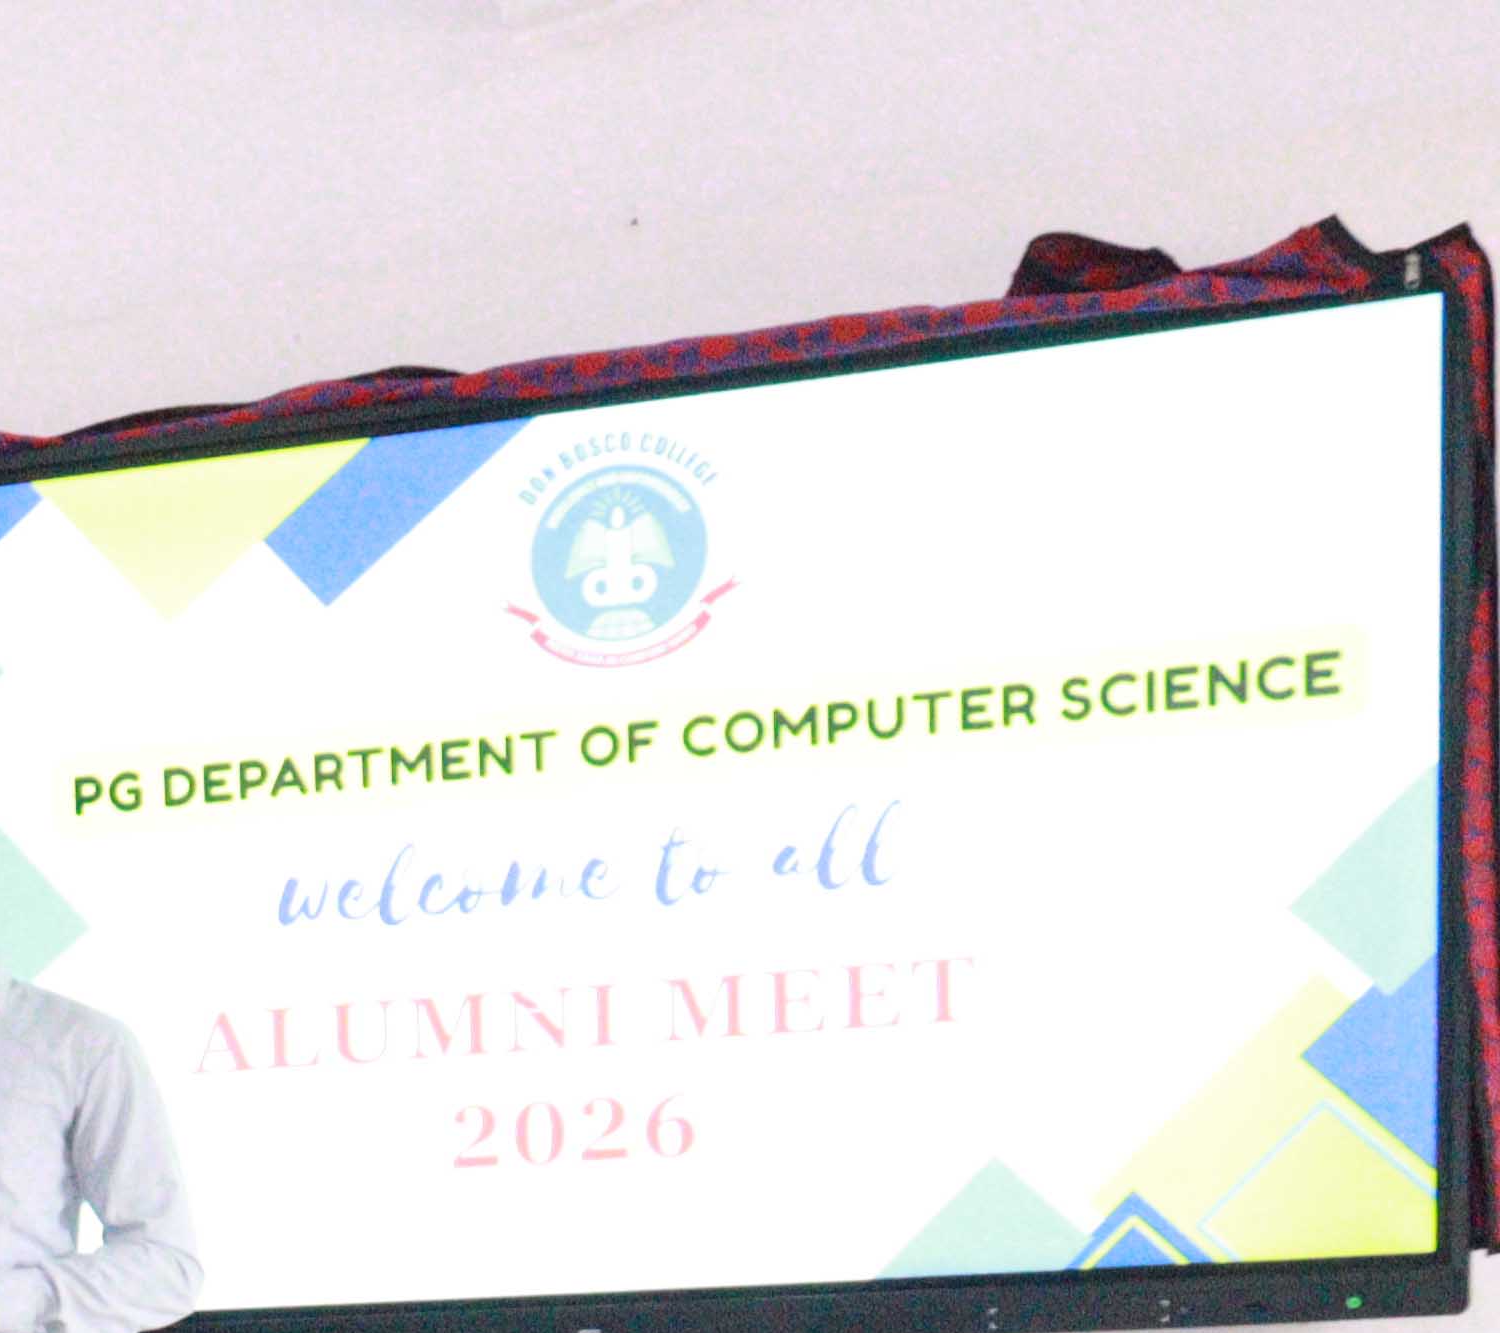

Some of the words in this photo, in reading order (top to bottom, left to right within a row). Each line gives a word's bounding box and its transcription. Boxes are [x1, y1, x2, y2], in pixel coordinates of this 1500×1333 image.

[558, 431, 631, 470] BOSCO
[639, 432, 718, 486] COLLEGE
[73, 772, 142, 815] PG
[163, 730, 557, 807] DEPARTMENT
[580, 721, 658, 767] OF
[682, 684, 1036, 757] COMPUTER
[1060, 651, 1342, 720] SCIENCE
[278, 843, 618, 926] welcome
[654, 827, 728, 906] to
[771, 800, 901, 889] all
[192, 984, 615, 1073] ALUMNI
[667, 956, 975, 1042] MEET
[453, 1094, 696, 1168] 2026
